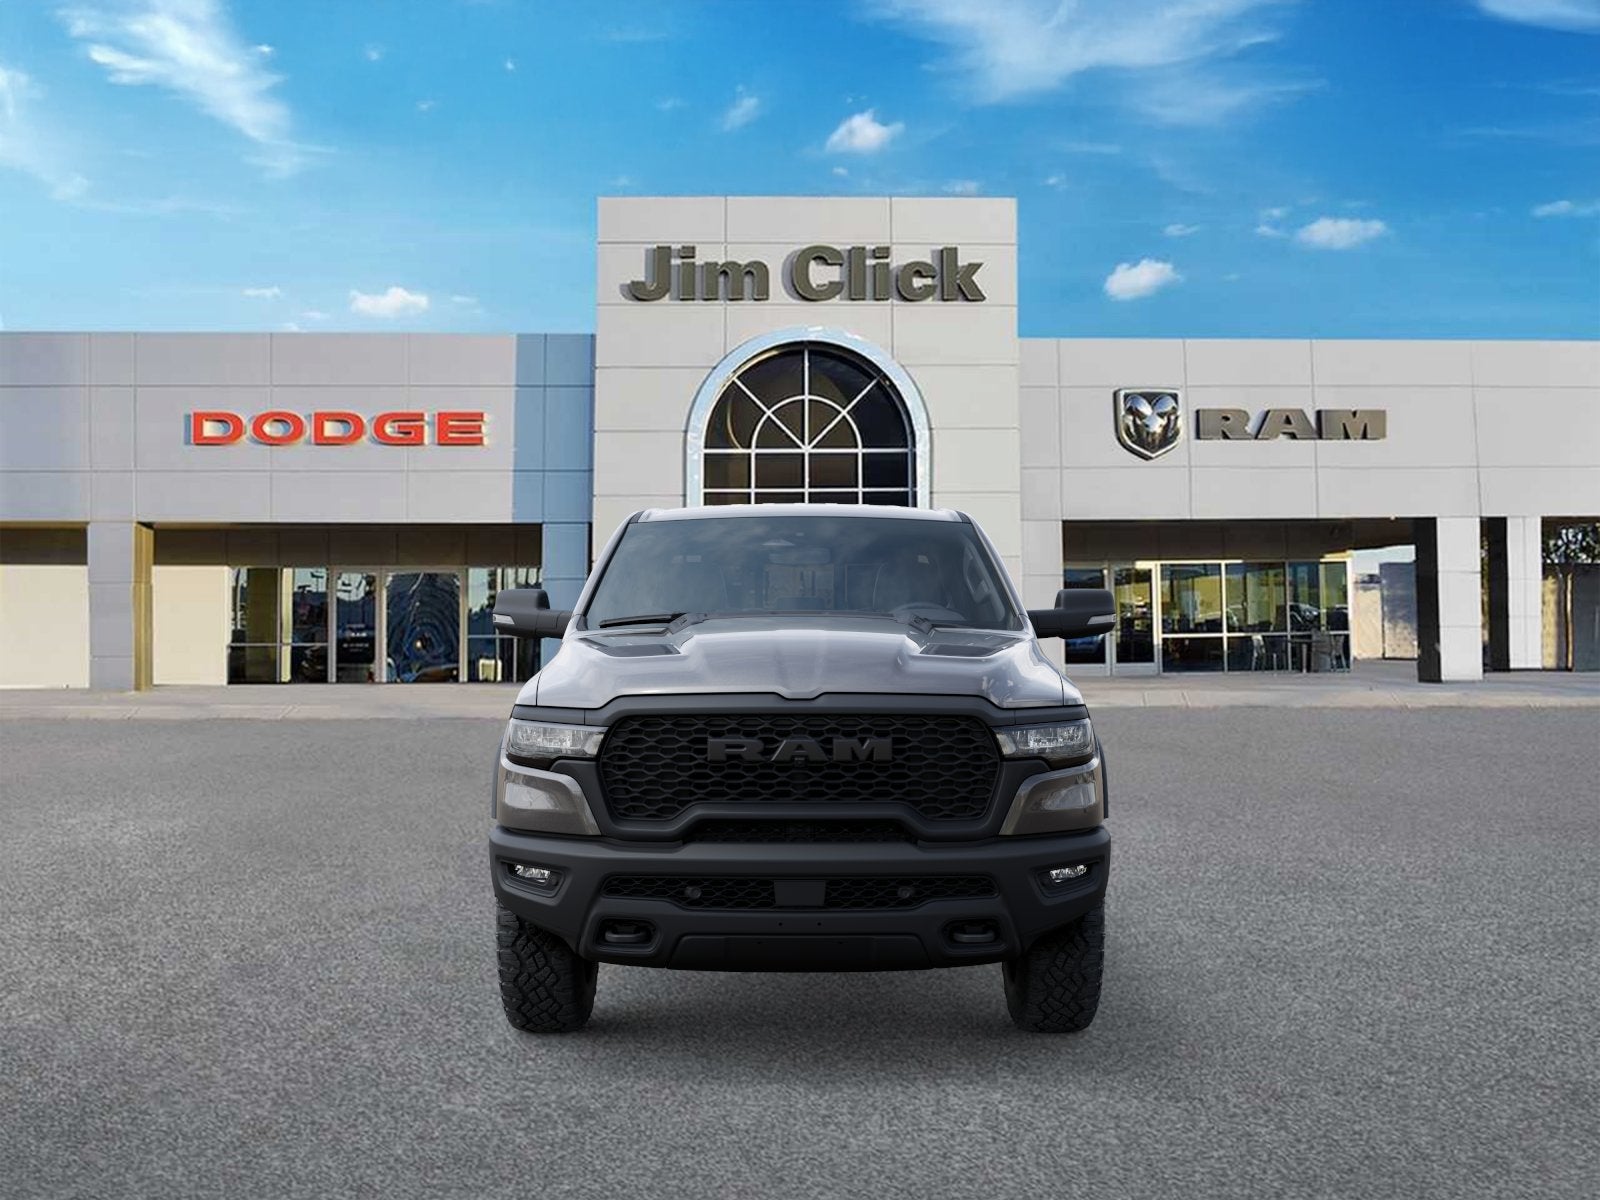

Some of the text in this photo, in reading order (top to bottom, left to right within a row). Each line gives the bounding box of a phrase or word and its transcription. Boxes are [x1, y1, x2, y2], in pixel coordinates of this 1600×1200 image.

[621, 245, 986, 302] Jim Click
[187, 410, 488, 446] DODGE
[1196, 408, 1387, 440] RAM
[707, 737, 892, 762] RAM
